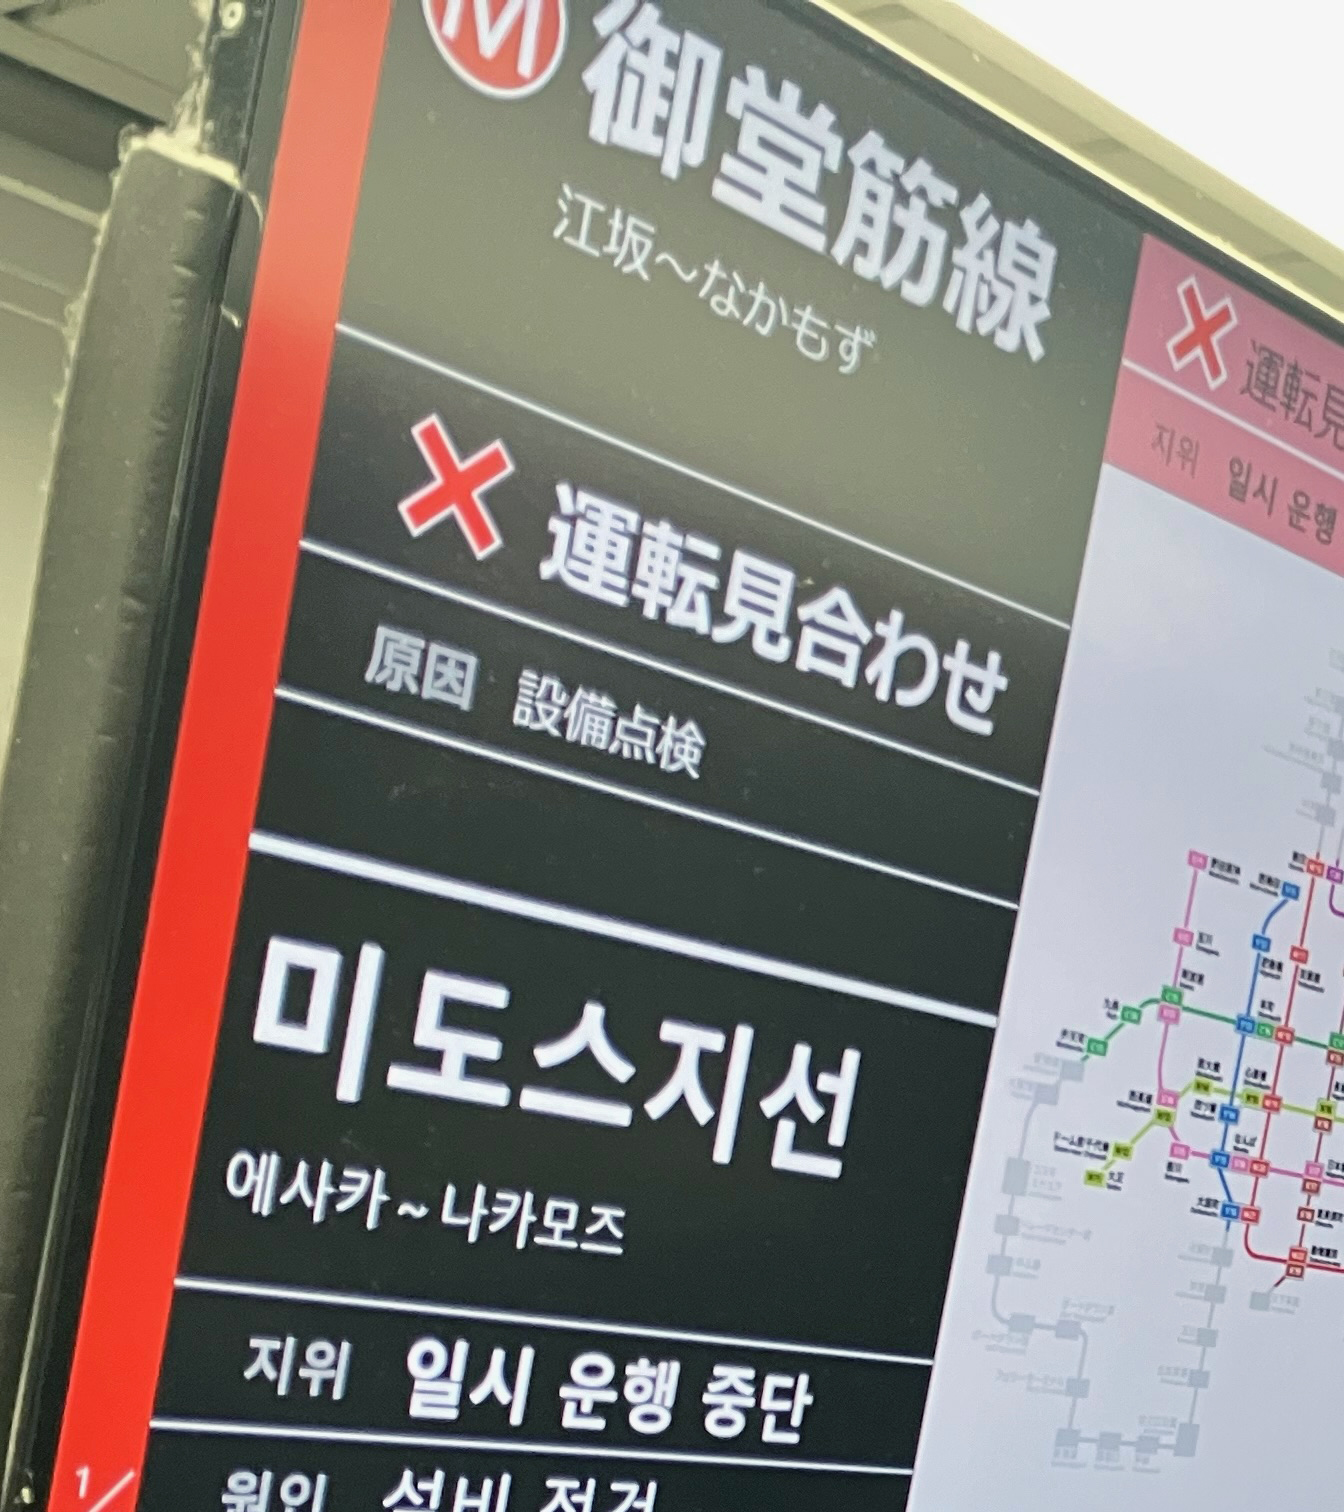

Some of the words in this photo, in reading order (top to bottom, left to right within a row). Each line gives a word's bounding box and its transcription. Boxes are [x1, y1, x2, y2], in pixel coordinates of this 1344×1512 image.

[580, 3, 1058, 361] 御堂筋線
[1152, 421, 1199, 479] 지위
[1229, 456, 1278, 518] 일시
[1288, 489, 1337, 545] 운행
[365, 625, 478, 709] 原因
[513, 670, 707, 779] 設備点検
[539, 483, 1007, 736] 運転見合わせ
[252, 934, 861, 1179] 미도스지선
[244, 1335, 352, 1400] 지위
[406, 1338, 534, 1426] 일시
[559, 1350, 679, 1432] 운행
[702, 1365, 813, 1445] 중단
